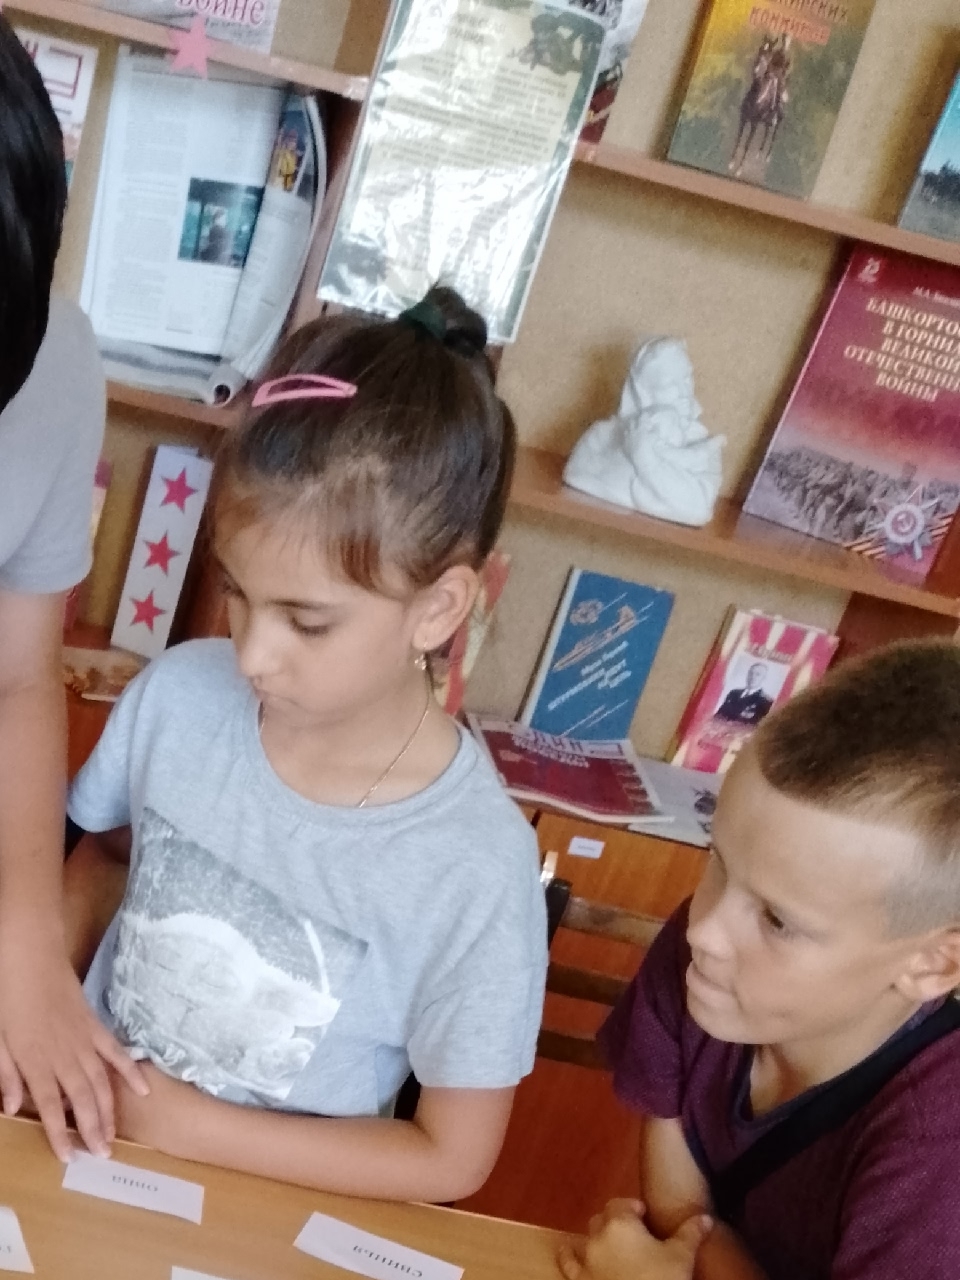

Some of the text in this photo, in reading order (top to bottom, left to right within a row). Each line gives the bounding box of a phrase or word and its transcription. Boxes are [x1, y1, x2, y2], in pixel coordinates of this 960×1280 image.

[866, 297, 960, 337] БАШКОРТО
[876, 371, 938, 402] ВОЙНЫ
[112, 1174, 159, 1193] овца
[352, 1244, 424, 1278] свинья
